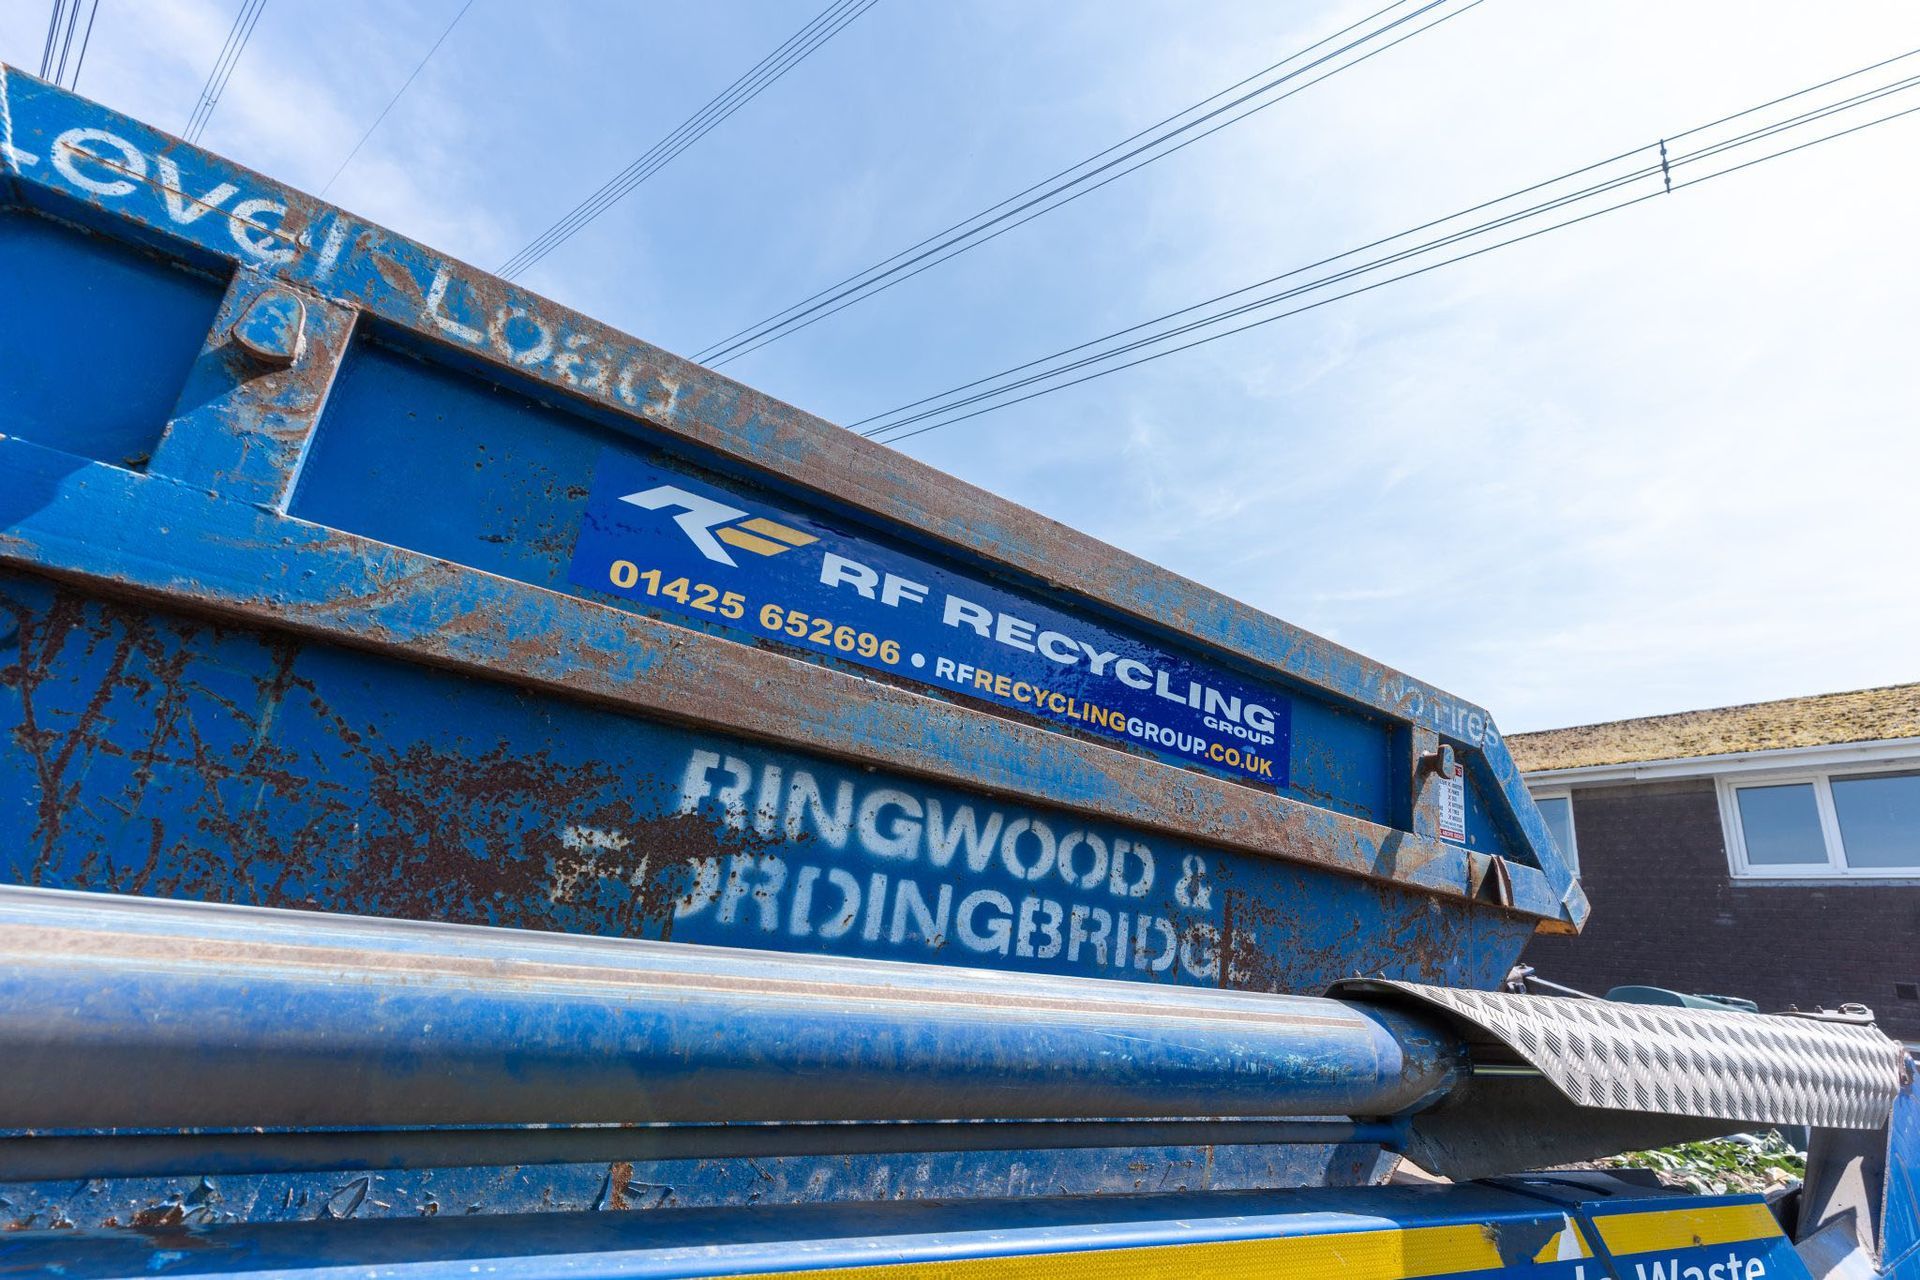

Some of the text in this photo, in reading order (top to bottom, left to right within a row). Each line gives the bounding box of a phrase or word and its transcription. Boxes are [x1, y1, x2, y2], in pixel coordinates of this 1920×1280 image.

[609, 560, 1273, 777] 01425 652696 RFRECYCLINGGROUP.CO.UK
[820, 552, 929, 607] RF
[943, 594, 1275, 734] RECYCLING
[1203, 716, 1275, 745] GROUP
[677, 748, 1213, 910] RINGWOOD &
